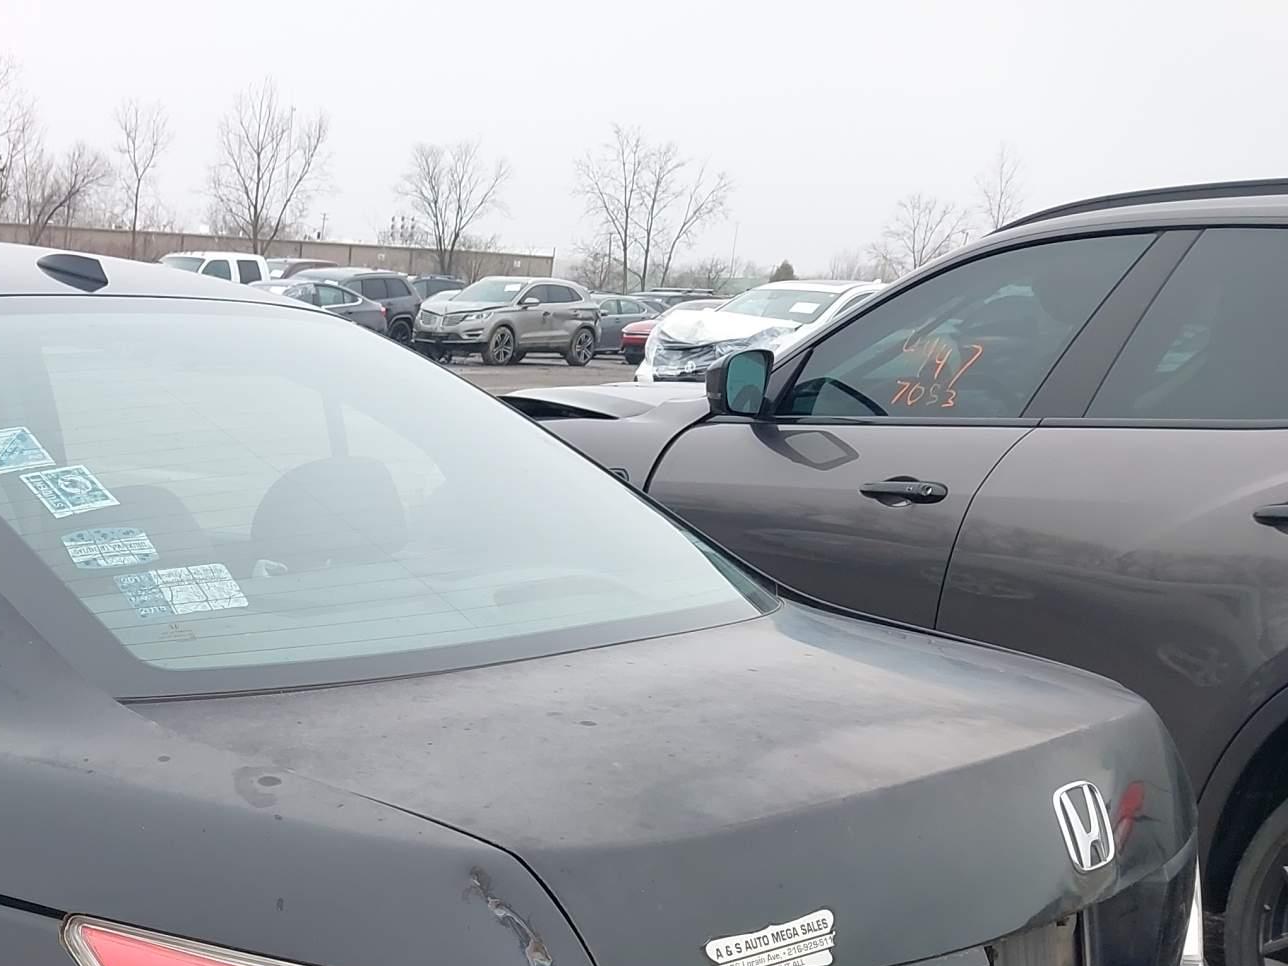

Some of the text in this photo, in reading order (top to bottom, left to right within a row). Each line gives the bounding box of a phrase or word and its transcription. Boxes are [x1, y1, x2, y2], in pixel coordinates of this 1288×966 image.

[715, 917, 829, 960] A & S AUTO MEGA SALES
